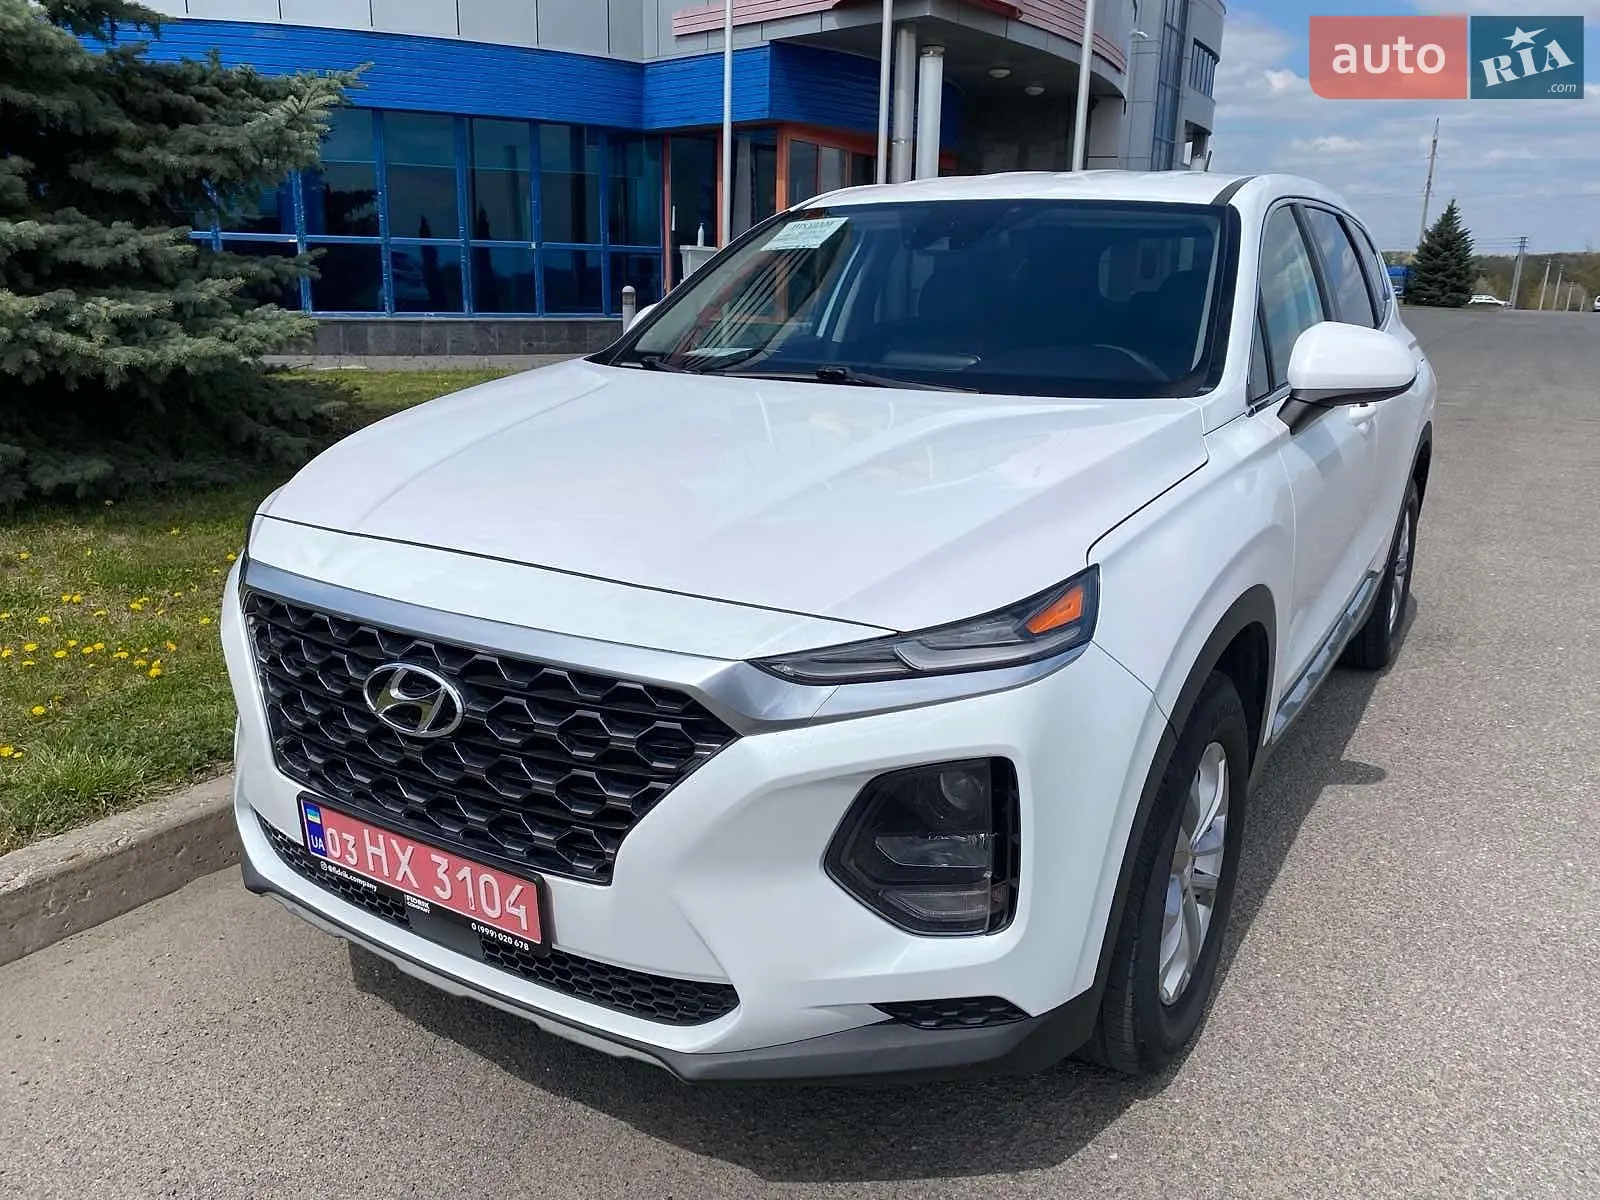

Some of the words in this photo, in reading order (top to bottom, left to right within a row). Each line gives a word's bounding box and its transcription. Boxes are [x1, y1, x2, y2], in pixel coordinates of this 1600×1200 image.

[311, 834, 325, 852] UA
[326, 826, 358, 867] 03
[363, 828, 419, 889] HX
[430, 854, 530, 931] 3104
[478, 925, 497, 938] (999)
[498, 933, 513, 945] 020
[514, 939, 530, 951] 678
